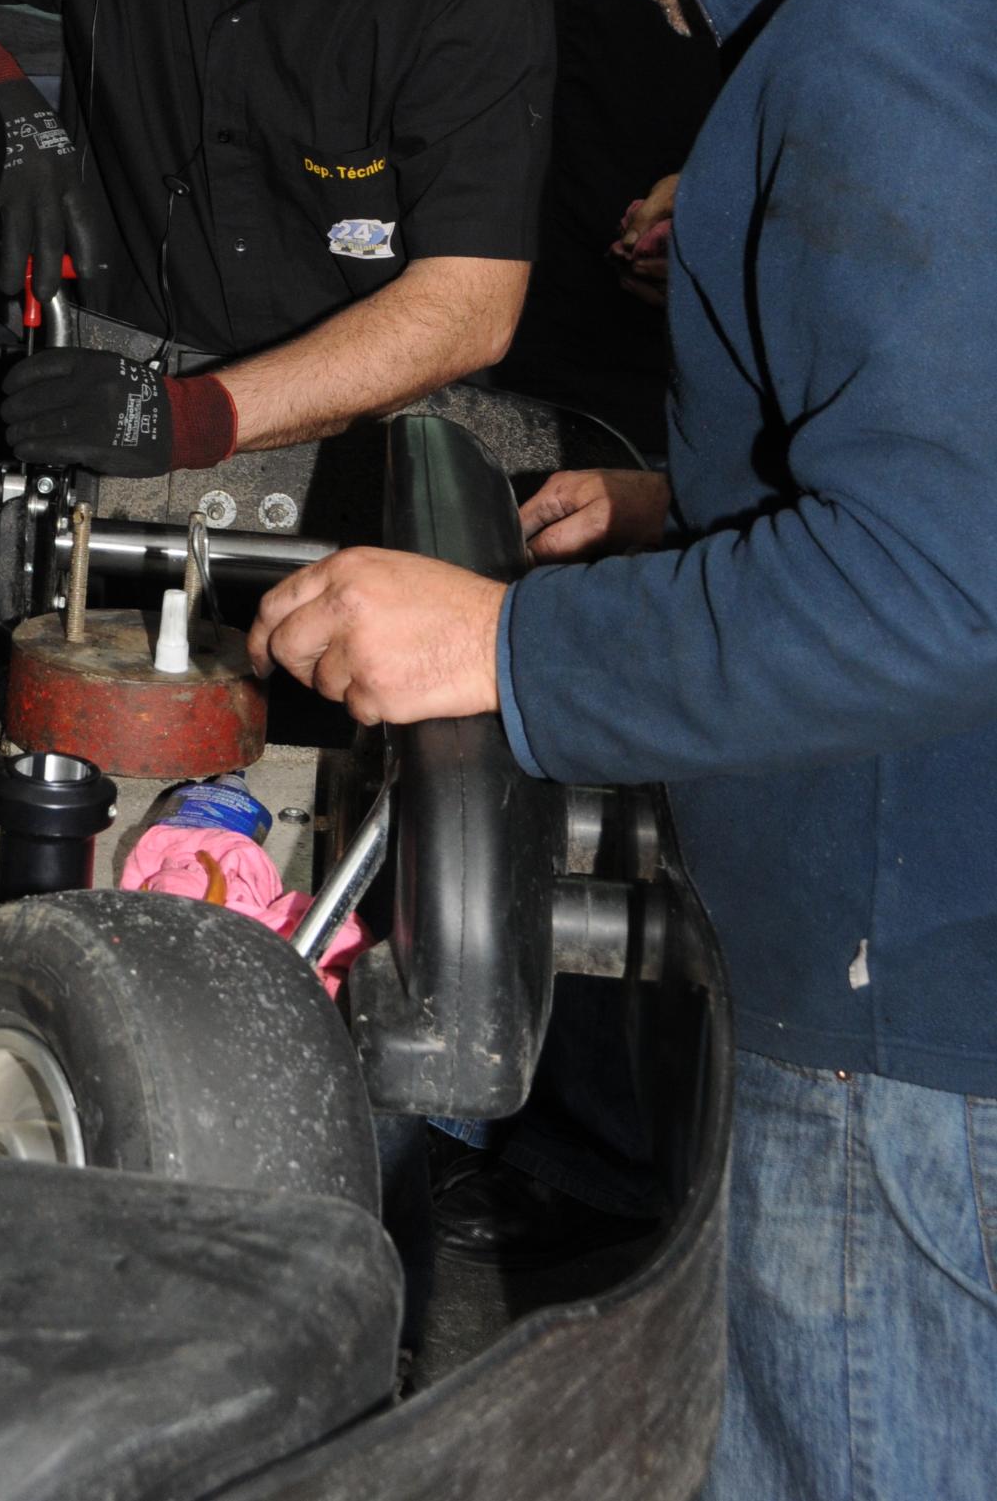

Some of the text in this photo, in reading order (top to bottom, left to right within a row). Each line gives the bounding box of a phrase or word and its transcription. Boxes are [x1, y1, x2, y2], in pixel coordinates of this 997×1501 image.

[304, 156, 387, 179] Dep. Técnic
[336, 222, 373, 242] 24
